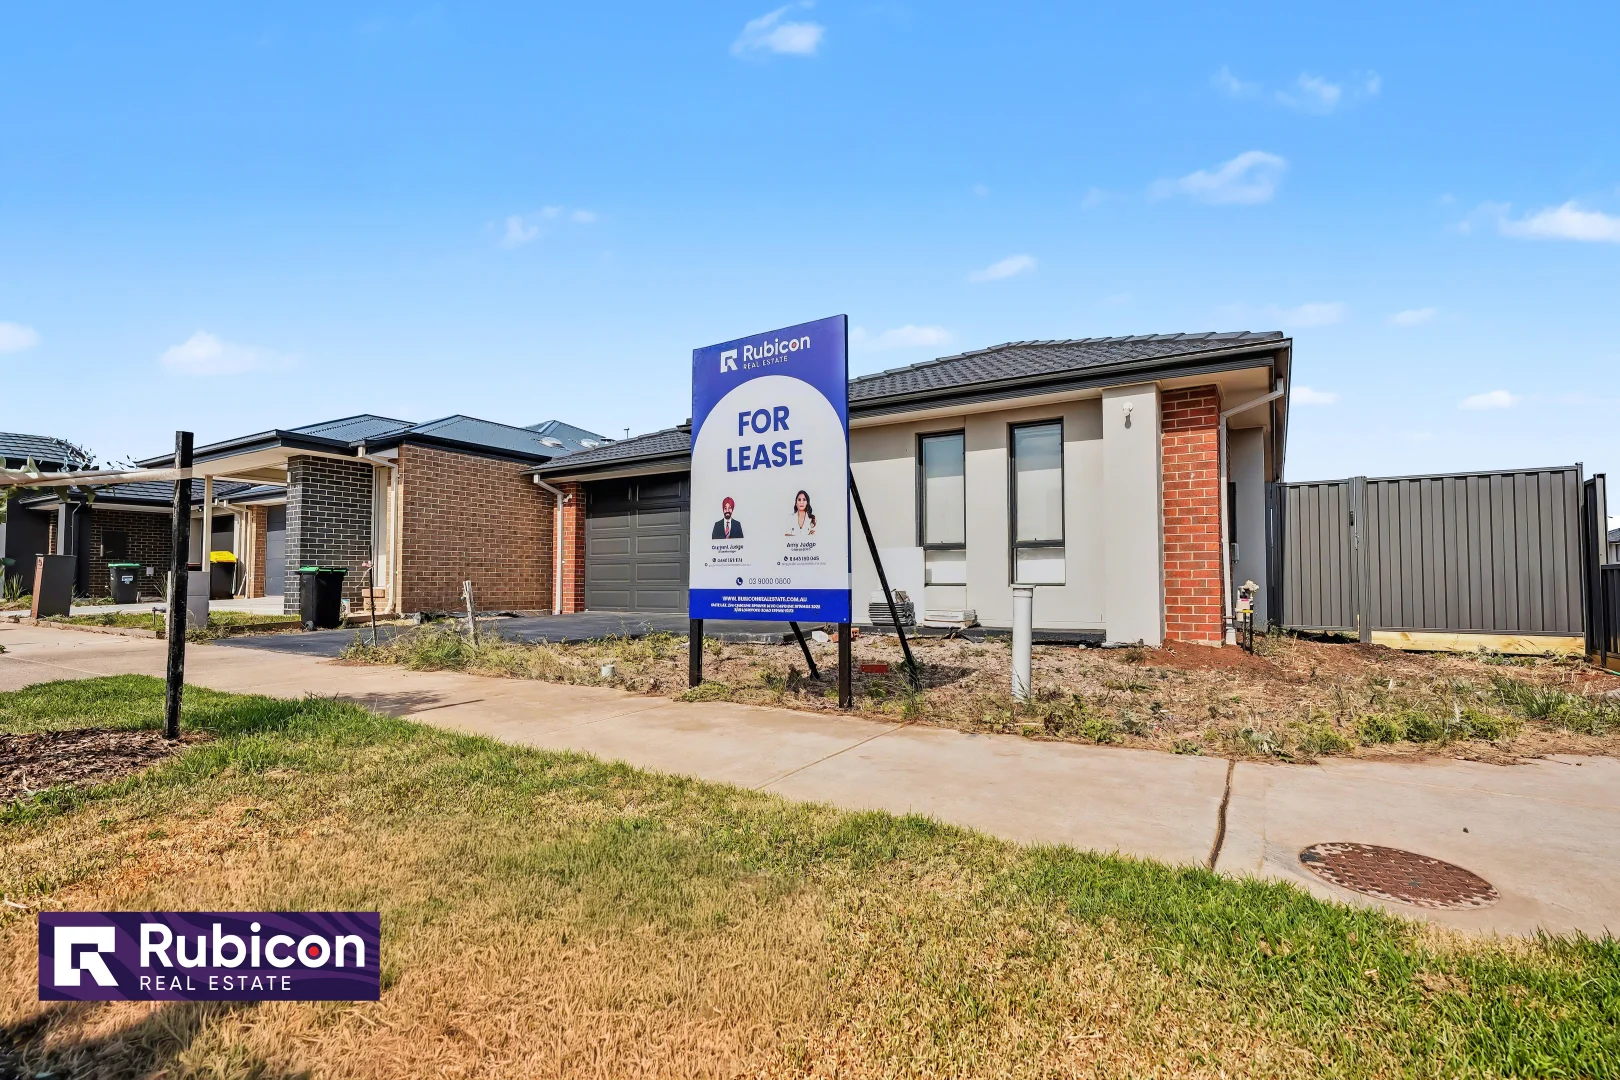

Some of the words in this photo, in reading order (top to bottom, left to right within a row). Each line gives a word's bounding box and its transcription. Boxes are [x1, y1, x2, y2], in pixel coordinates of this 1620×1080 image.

[743, 335, 811, 361] Rubicon
[743, 362, 760, 370] REAL
[762, 355, 788, 367] ESTATE
[738, 405, 790, 436] FOR
[727, 439, 803, 472] LEASE
[748, 577, 757, 585] 03
